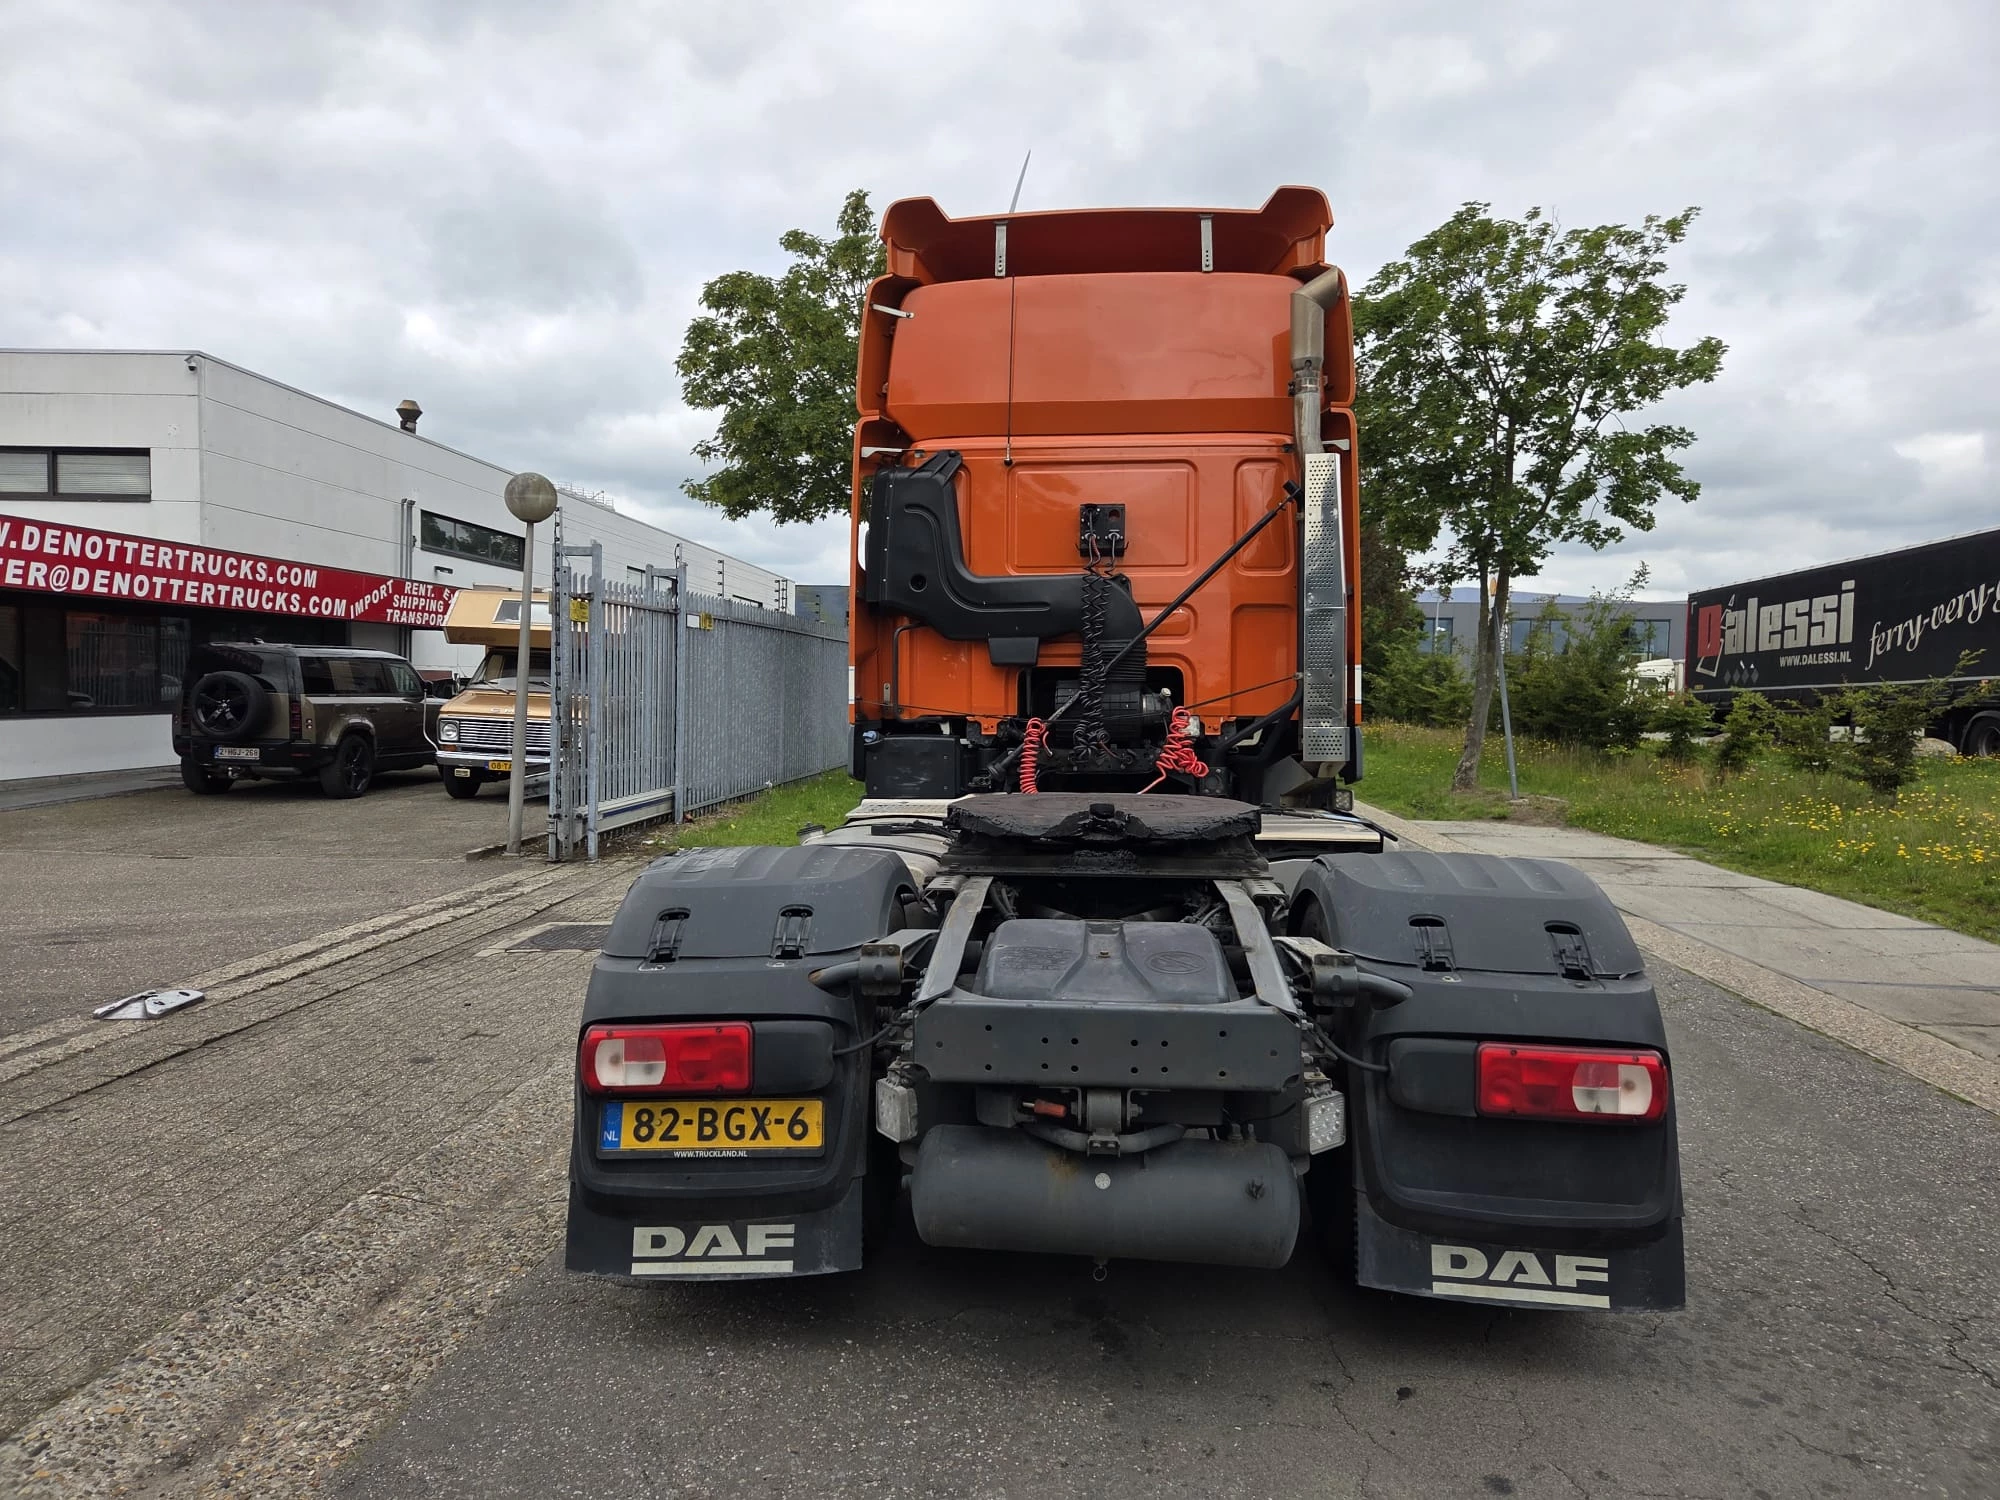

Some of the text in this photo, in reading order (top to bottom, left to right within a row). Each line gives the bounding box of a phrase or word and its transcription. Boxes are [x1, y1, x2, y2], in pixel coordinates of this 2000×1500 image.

[0, 558, 347, 617] ER@DENOTTERTRUCKS.COM
[350, 579, 394, 620] IMPORT
[404, 581, 435, 598] RENT.
[392, 594, 444, 613] SHIPPING
[1779, 650, 1852, 668] WWW.DALESSI.NL
[603, 1130, 619, 1142] NL
[632, 1106, 809, 1143] 82-BGX-6
[673, 1150, 749, 1158] WWW.TRUCKLAND.NL
[632, 1224, 795, 1257] DAF
[1431, 1243, 1609, 1288] DAF
